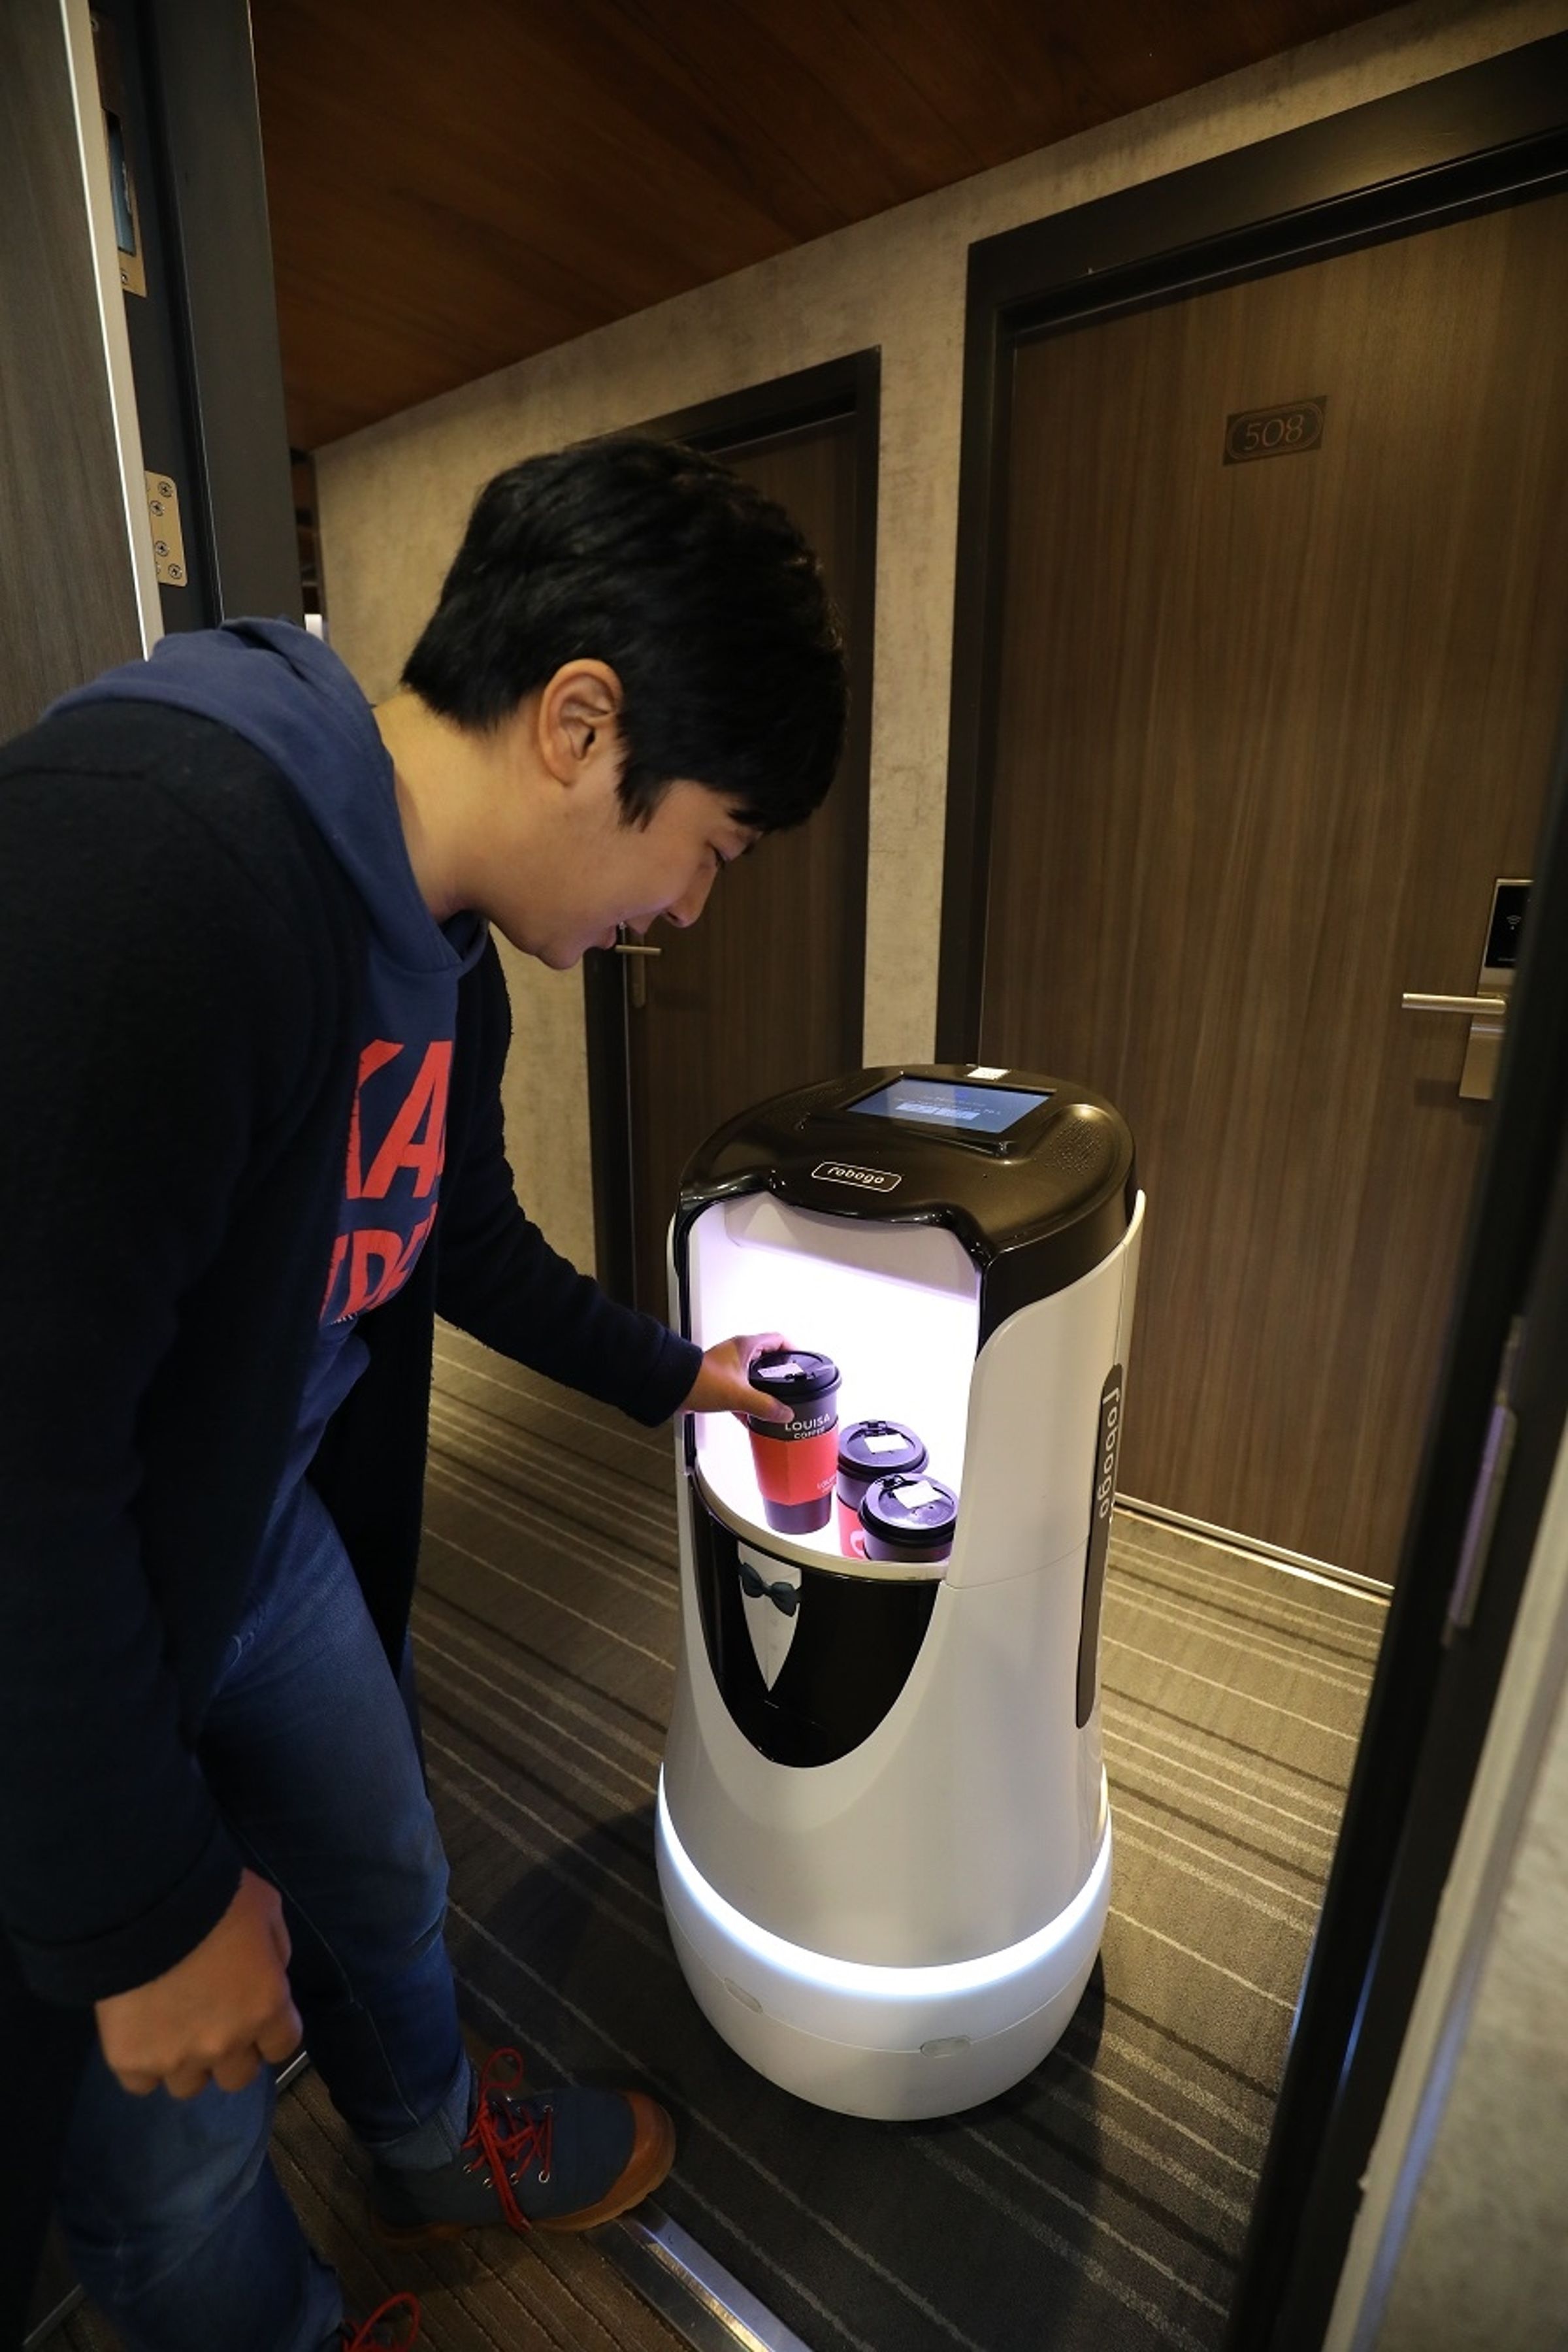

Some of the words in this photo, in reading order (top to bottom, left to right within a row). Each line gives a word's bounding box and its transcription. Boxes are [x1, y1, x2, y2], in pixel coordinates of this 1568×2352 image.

[1245, 415, 1304, 450] 508
[827, 1167, 885, 1183] robogo
[785, 1413, 830, 1431] LOUISA
[1098, 1387, 1120, 1518] robogo
